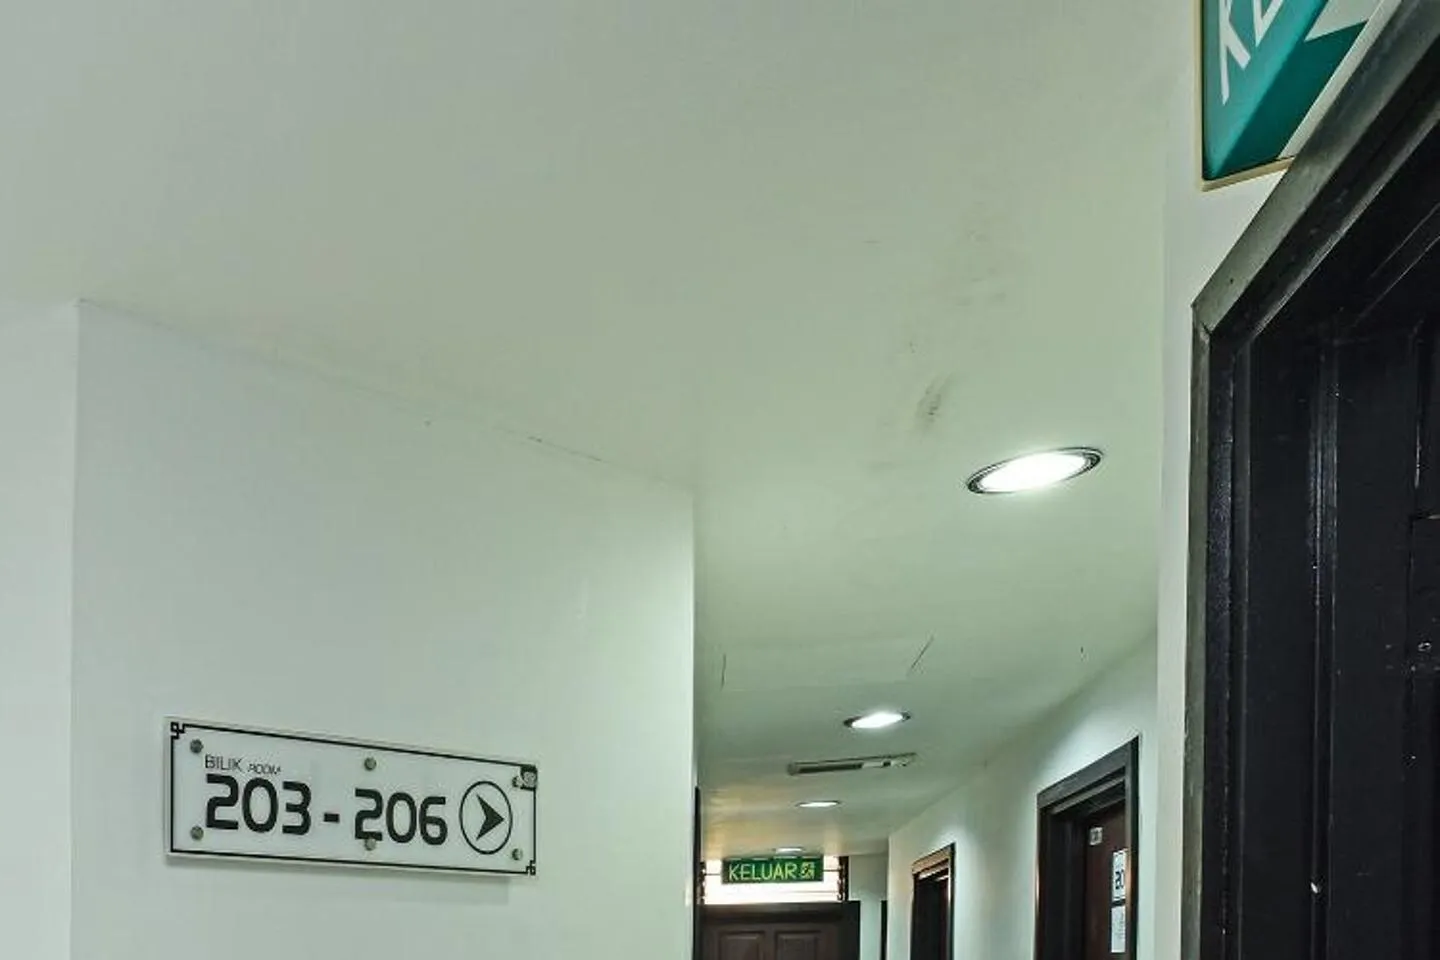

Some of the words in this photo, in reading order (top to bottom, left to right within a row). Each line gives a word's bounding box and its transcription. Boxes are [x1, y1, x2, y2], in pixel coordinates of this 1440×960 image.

[205, 753, 243, 772] BILIK
[205, 773, 312, 835] 203
[354, 787, 448, 846] 206
[728, 861, 798, 881] KELUAR
